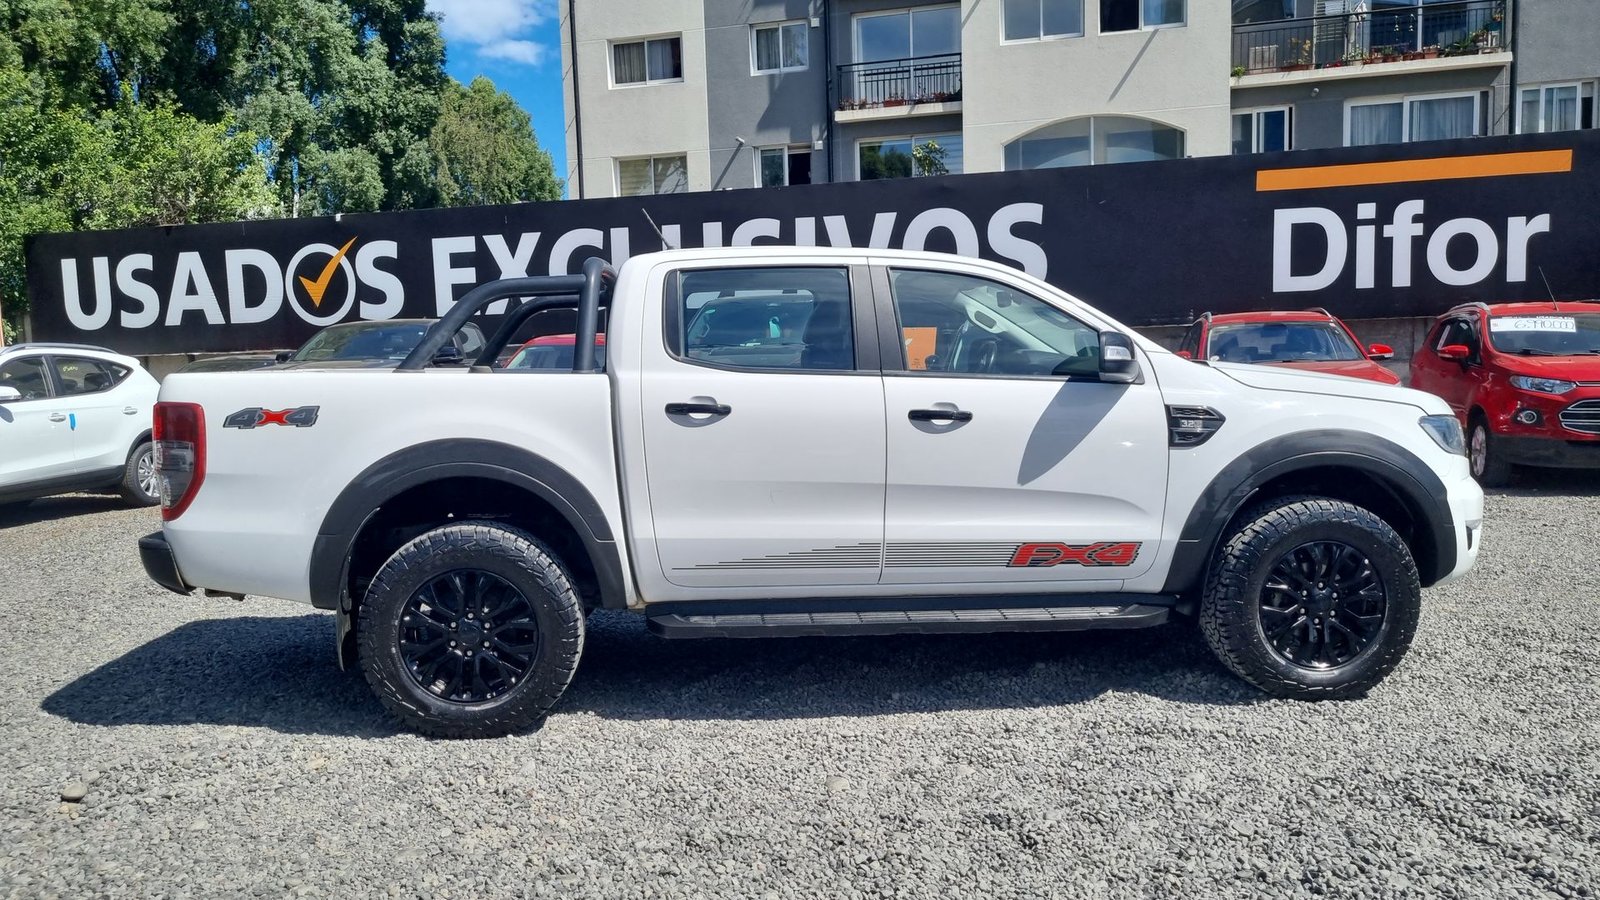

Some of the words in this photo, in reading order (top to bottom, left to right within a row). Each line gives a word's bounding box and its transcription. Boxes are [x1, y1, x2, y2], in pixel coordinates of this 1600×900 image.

[60, 239, 405, 331] USADOS
[1272, 199, 1551, 293] Difor
[1006, 541, 1143, 567] FX4
